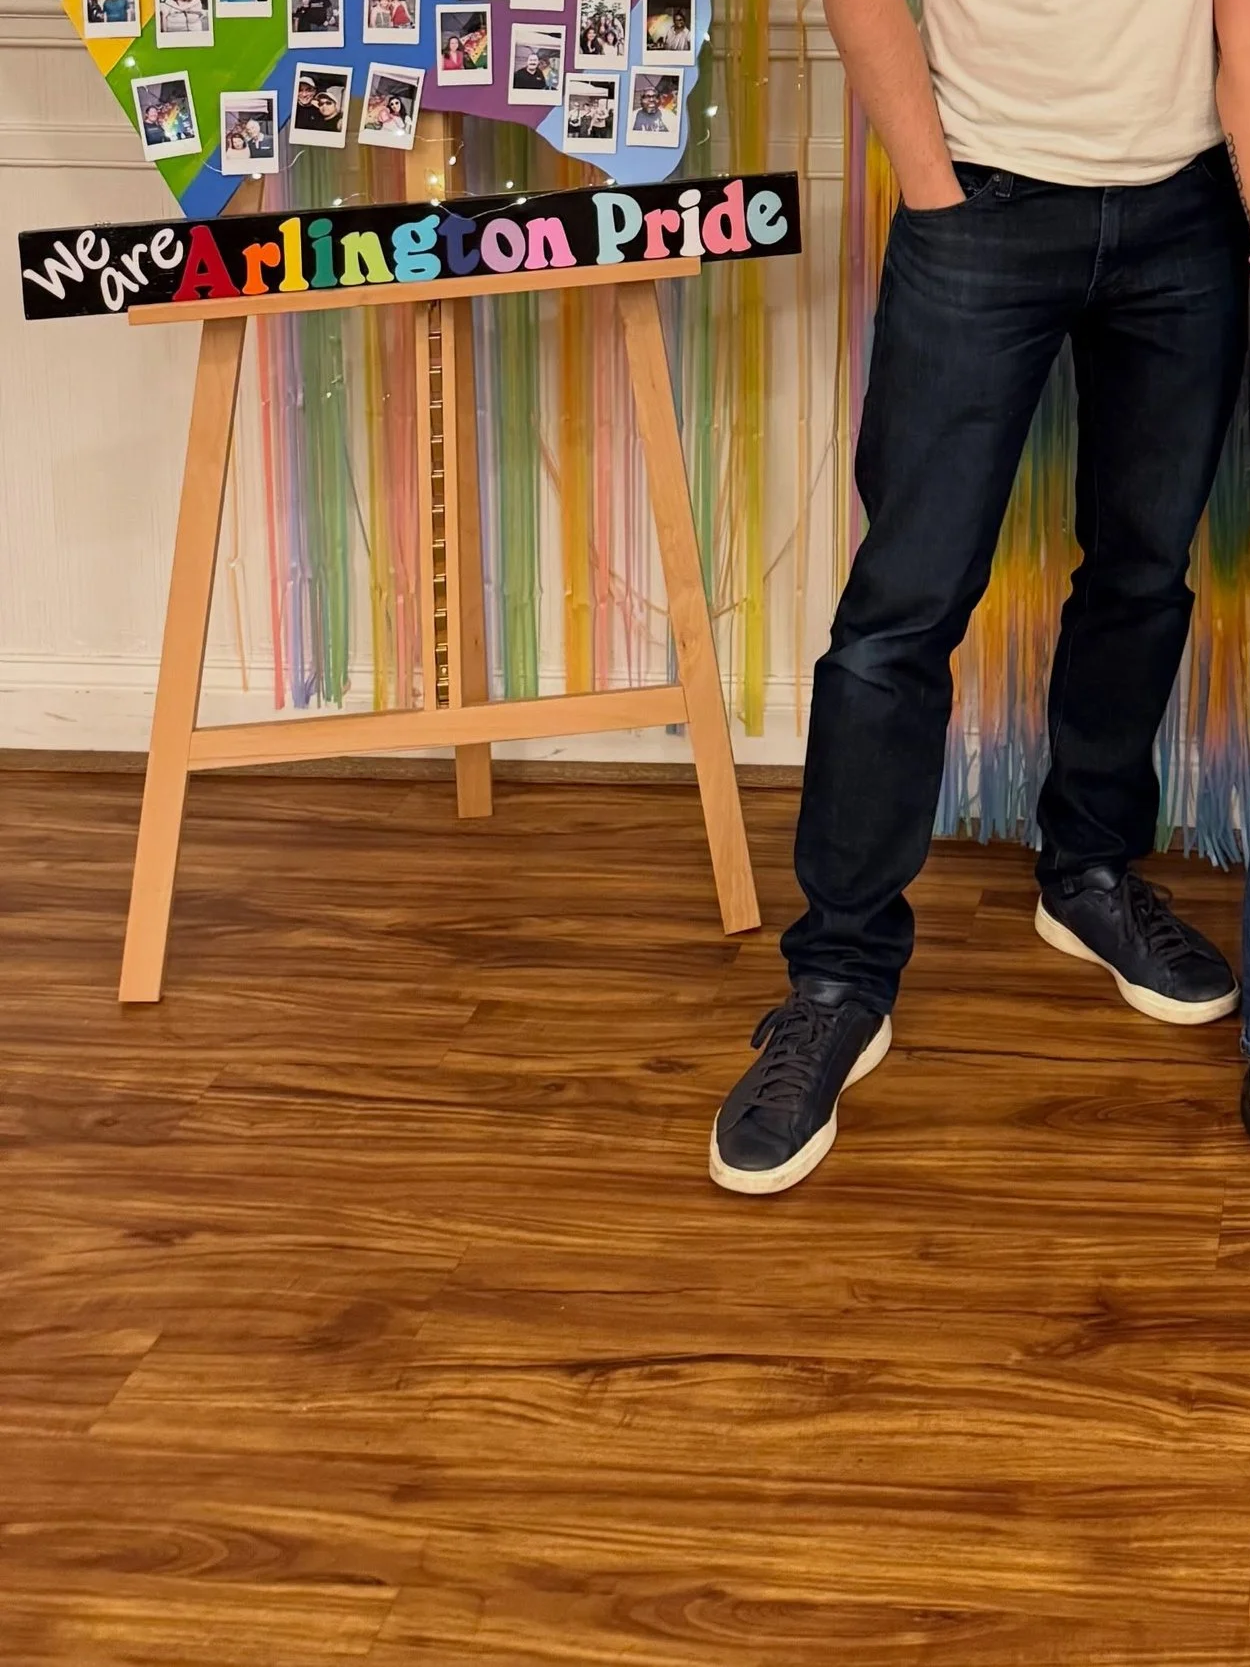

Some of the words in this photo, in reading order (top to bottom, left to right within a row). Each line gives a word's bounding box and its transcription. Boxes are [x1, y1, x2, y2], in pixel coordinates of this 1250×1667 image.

[100, 228, 184, 311] are
[172, 212, 577, 301] Arlington
[592, 179, 787, 265] Pride
